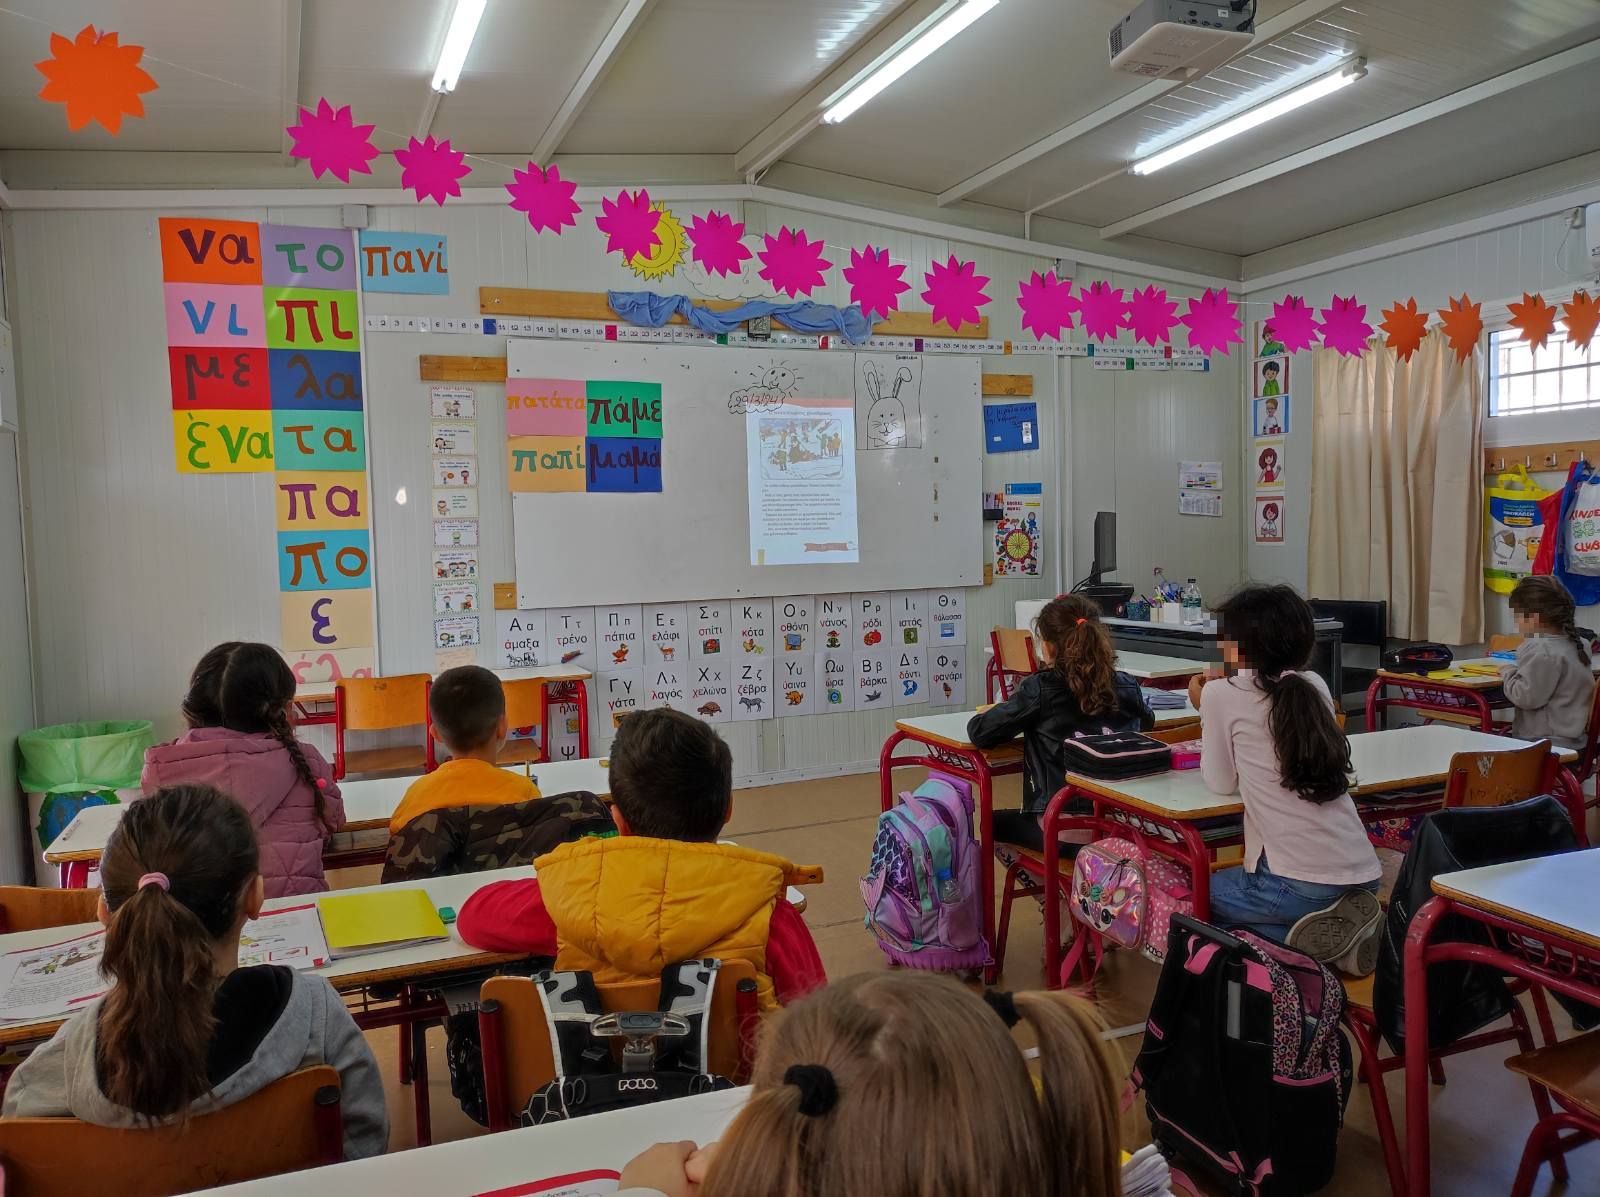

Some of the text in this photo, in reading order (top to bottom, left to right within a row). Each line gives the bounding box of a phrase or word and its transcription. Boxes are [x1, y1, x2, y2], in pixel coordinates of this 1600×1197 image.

[177, 228, 255, 265] να
[275, 243, 344, 274] το
[362, 242, 448, 277] πανί
[182, 300, 248, 336] νι
[275, 300, 354, 343] πι
[185, 353, 250, 400] με
[287, 354, 360, 400] λα
[507, 391, 585, 410] πατάτα
[587, 396, 662, 434] πάμε
[186, 412, 274, 469] ένα
[282, 425, 357, 455] τα
[512, 445, 585, 472] παπί
[590, 443, 661, 484] μαμά
[279, 483, 360, 520] πα
[1574, 540, 1600, 552] CLUB
[285, 542, 368, 586] πο
[310, 597, 338, 644] ε
[819, 618, 847, 628] νάνος
[862, 619, 882, 629] ρόδι
[899, 617, 922, 628] ιστός
[698, 626, 723, 636] σπίτι
[742, 625, 764, 637] κότα
[780, 622, 809, 633] οθόνη
[556, 634, 588, 647] τρένο
[604, 631, 635, 642] πάπια
[652, 630, 680, 643] ελάφι
[504, 638, 539, 651] άμαξα
[899, 669, 921, 680] δόντι
[933, 671, 963, 683] φανάρι
[783, 680, 806, 690] ύαινα
[825, 677, 843, 688] ώρα
[860, 676, 887, 688] βάρκα
[652, 688, 683, 701] λαγός
[692, 685, 727, 698] χελώνα
[737, 684, 767, 696] ζέβρα
[608, 697, 635, 710] γάτα
[561, 745, 575, 760] Ψ
[618, 1078, 656, 1091] POLO
